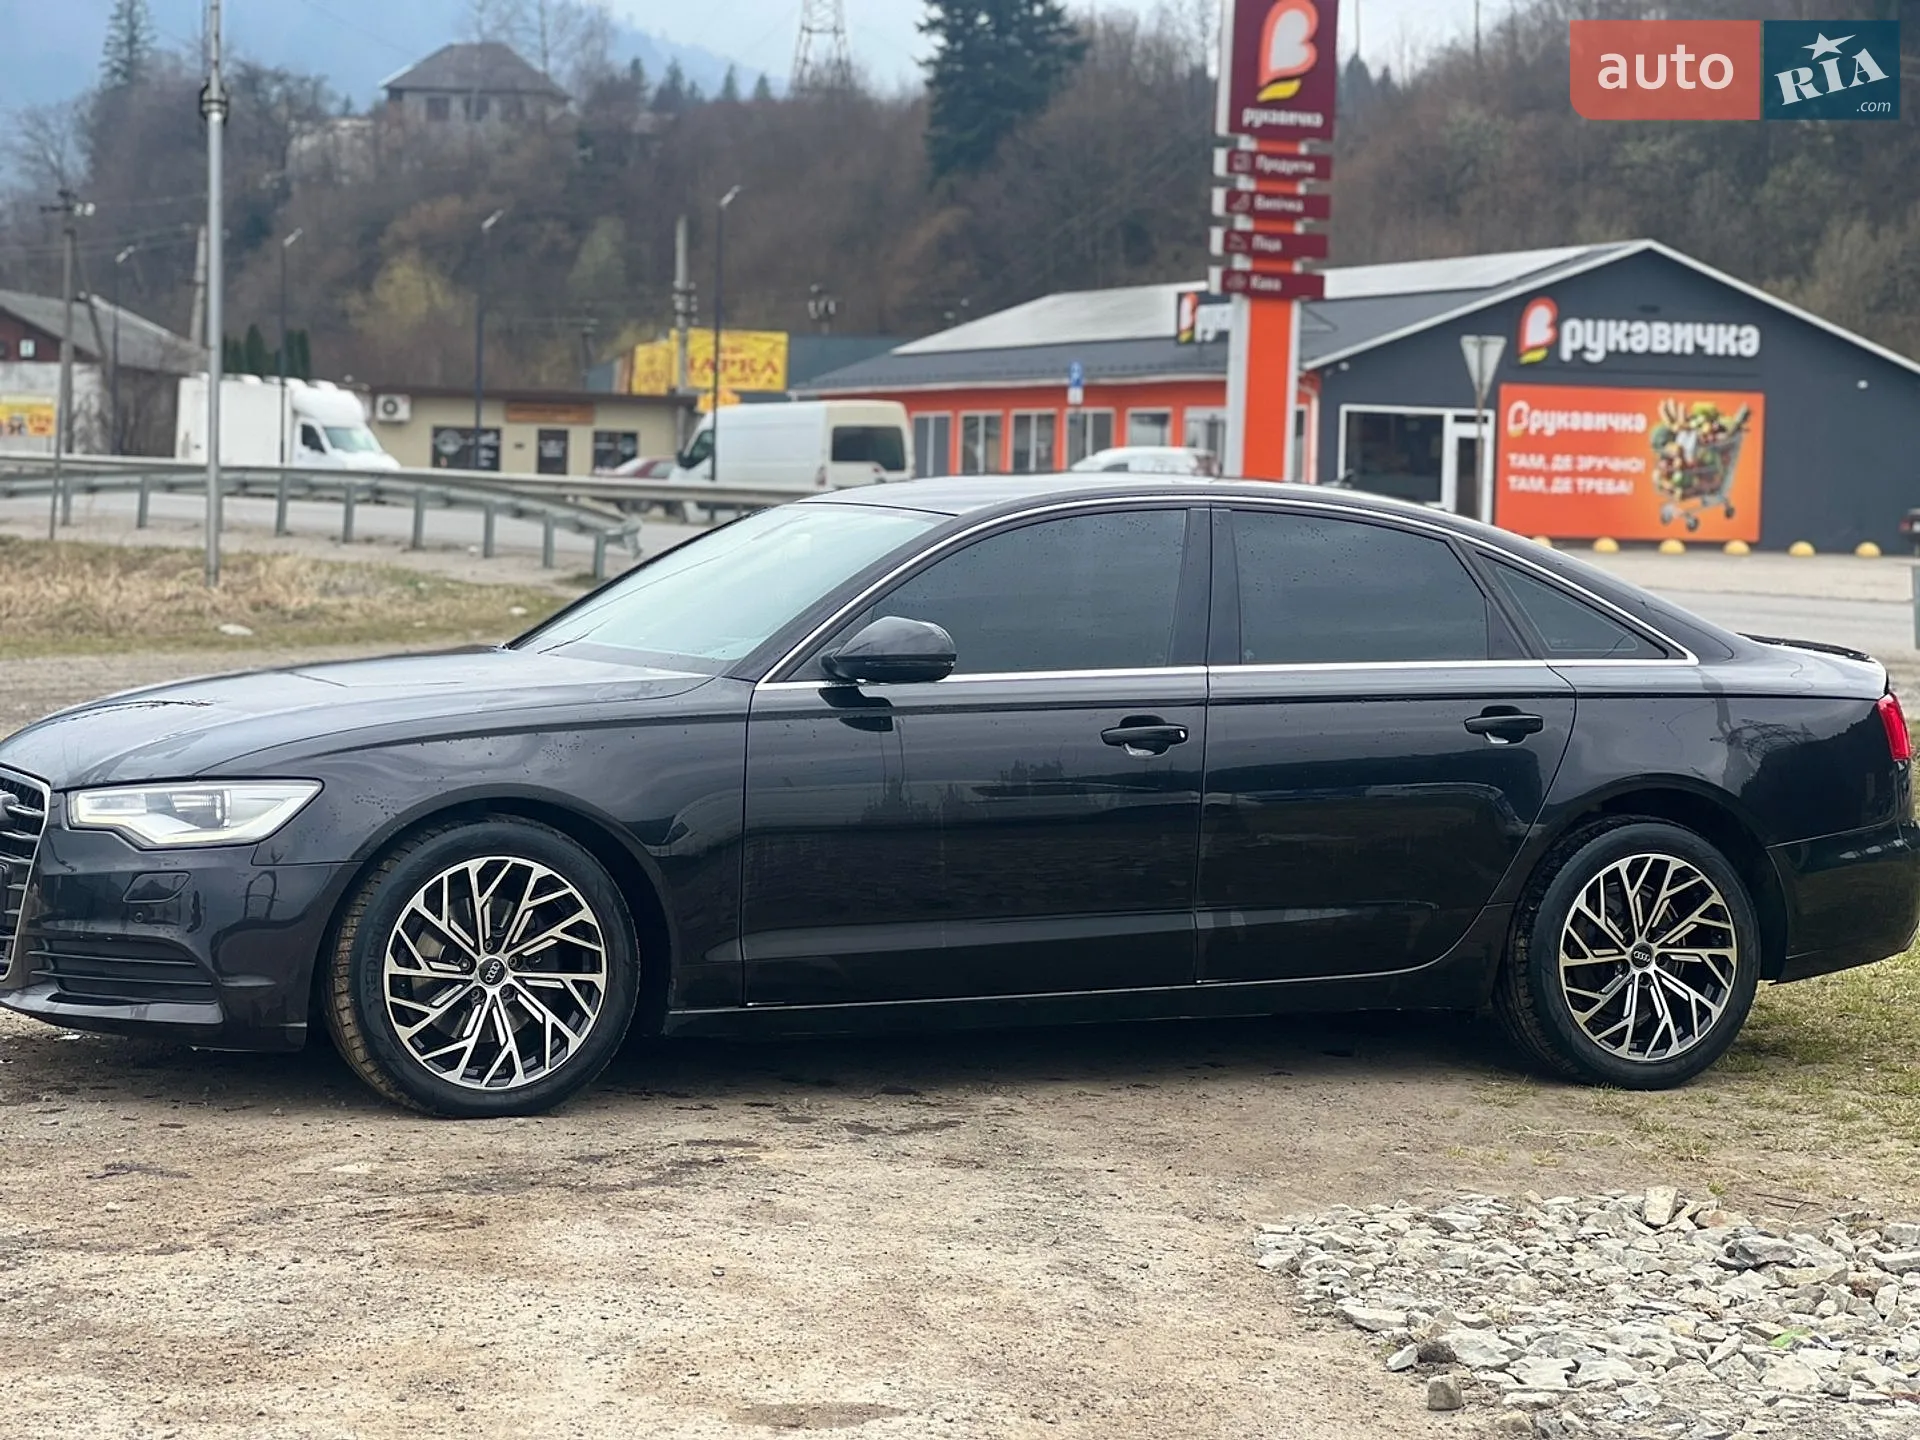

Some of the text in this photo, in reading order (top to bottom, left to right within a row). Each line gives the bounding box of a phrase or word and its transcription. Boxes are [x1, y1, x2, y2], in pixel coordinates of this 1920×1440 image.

[1242, 107, 1324, 128] рукавичка
[1560, 317, 1761, 363] рукавичка
[1528, 408, 1648, 437] рукавичка
[1551, 454, 1574, 472] ДЕ
[1576, 454, 1646, 473] ЗРУЧНО!
[1551, 476, 1573, 494] ДЕ
[1576, 477, 1635, 496] ТРЕБА!
